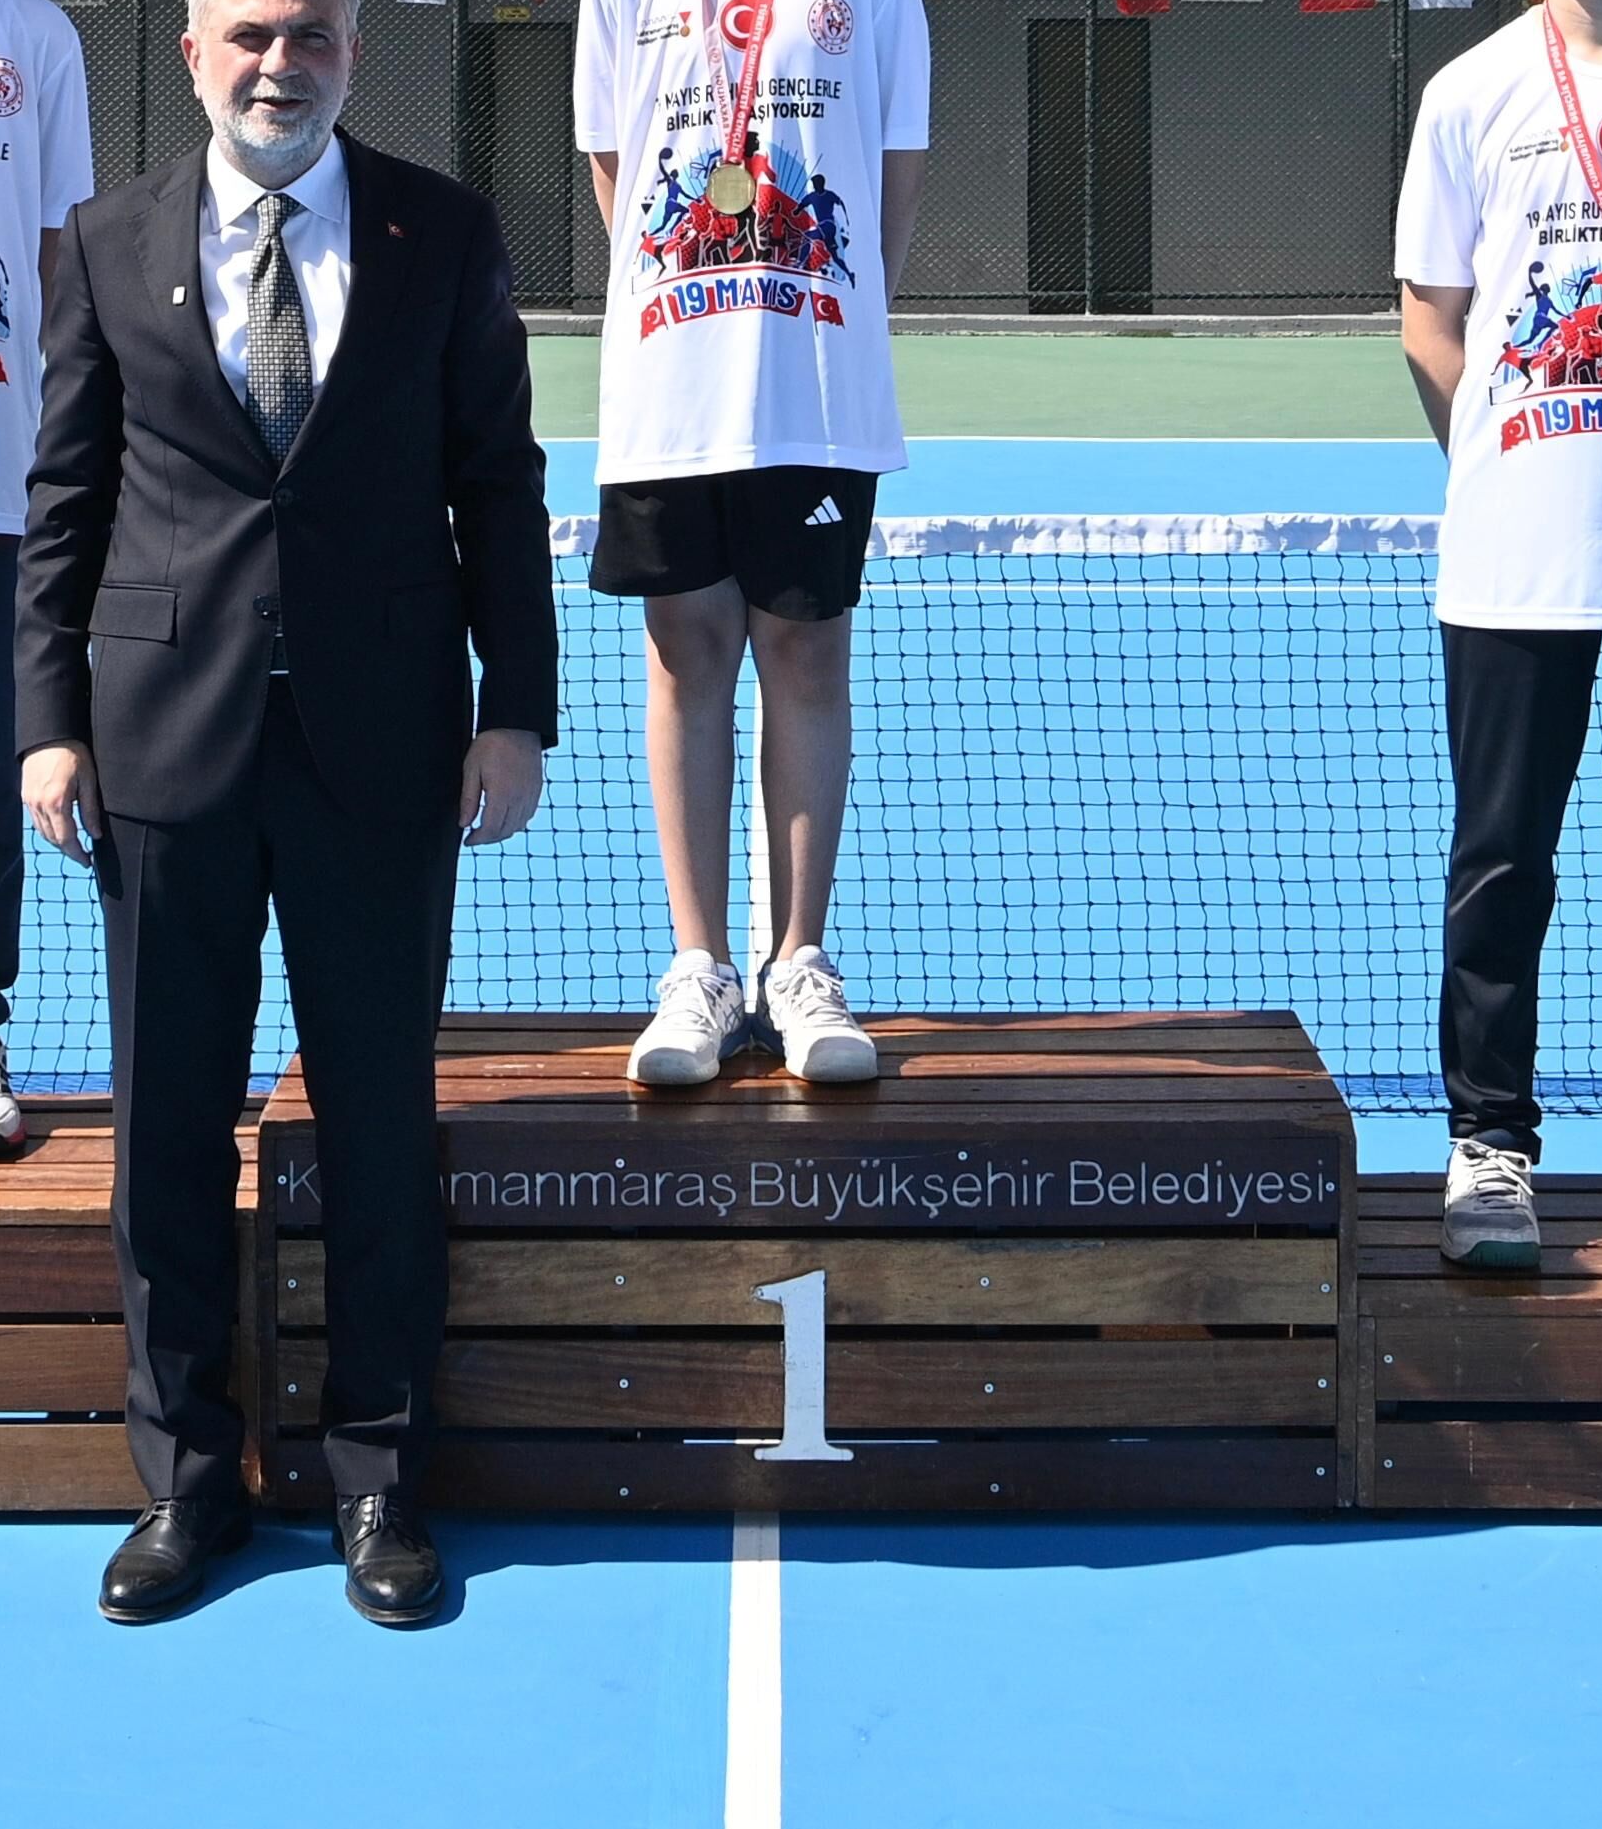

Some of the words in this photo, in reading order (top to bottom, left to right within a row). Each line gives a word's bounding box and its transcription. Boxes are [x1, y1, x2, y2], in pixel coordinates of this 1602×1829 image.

[1543, 201, 1577, 222] AYIS
[672, 281, 706, 317] 19
[714, 277, 798, 310] MAYIS
[1538, 398, 1572, 433] 19
[289, 1159, 737, 1217] Kmanmaraş
[749, 1158, 1055, 1221] Büyükşehir
[1069, 1159, 1324, 1218] Belediyesi
[753, 1268, 854, 1462] 1
